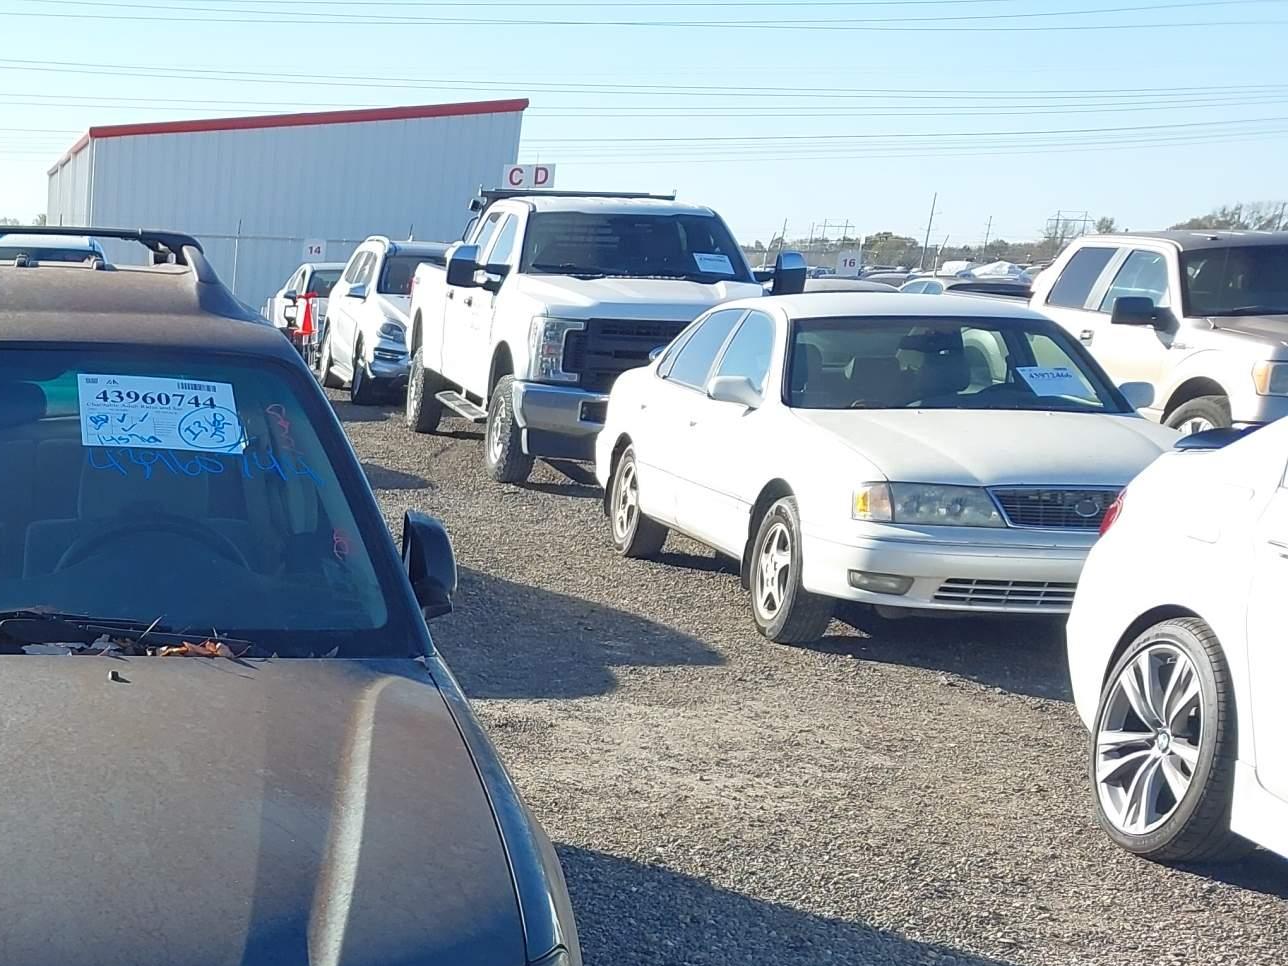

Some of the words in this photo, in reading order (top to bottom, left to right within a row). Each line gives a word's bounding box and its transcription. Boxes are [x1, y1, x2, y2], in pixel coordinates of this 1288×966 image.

[508, 167, 524, 186] C
[534, 166, 549, 185] D
[308, 245, 321, 255] 14
[842, 257, 856, 268] 16
[95, 388, 217, 409] 43960744
